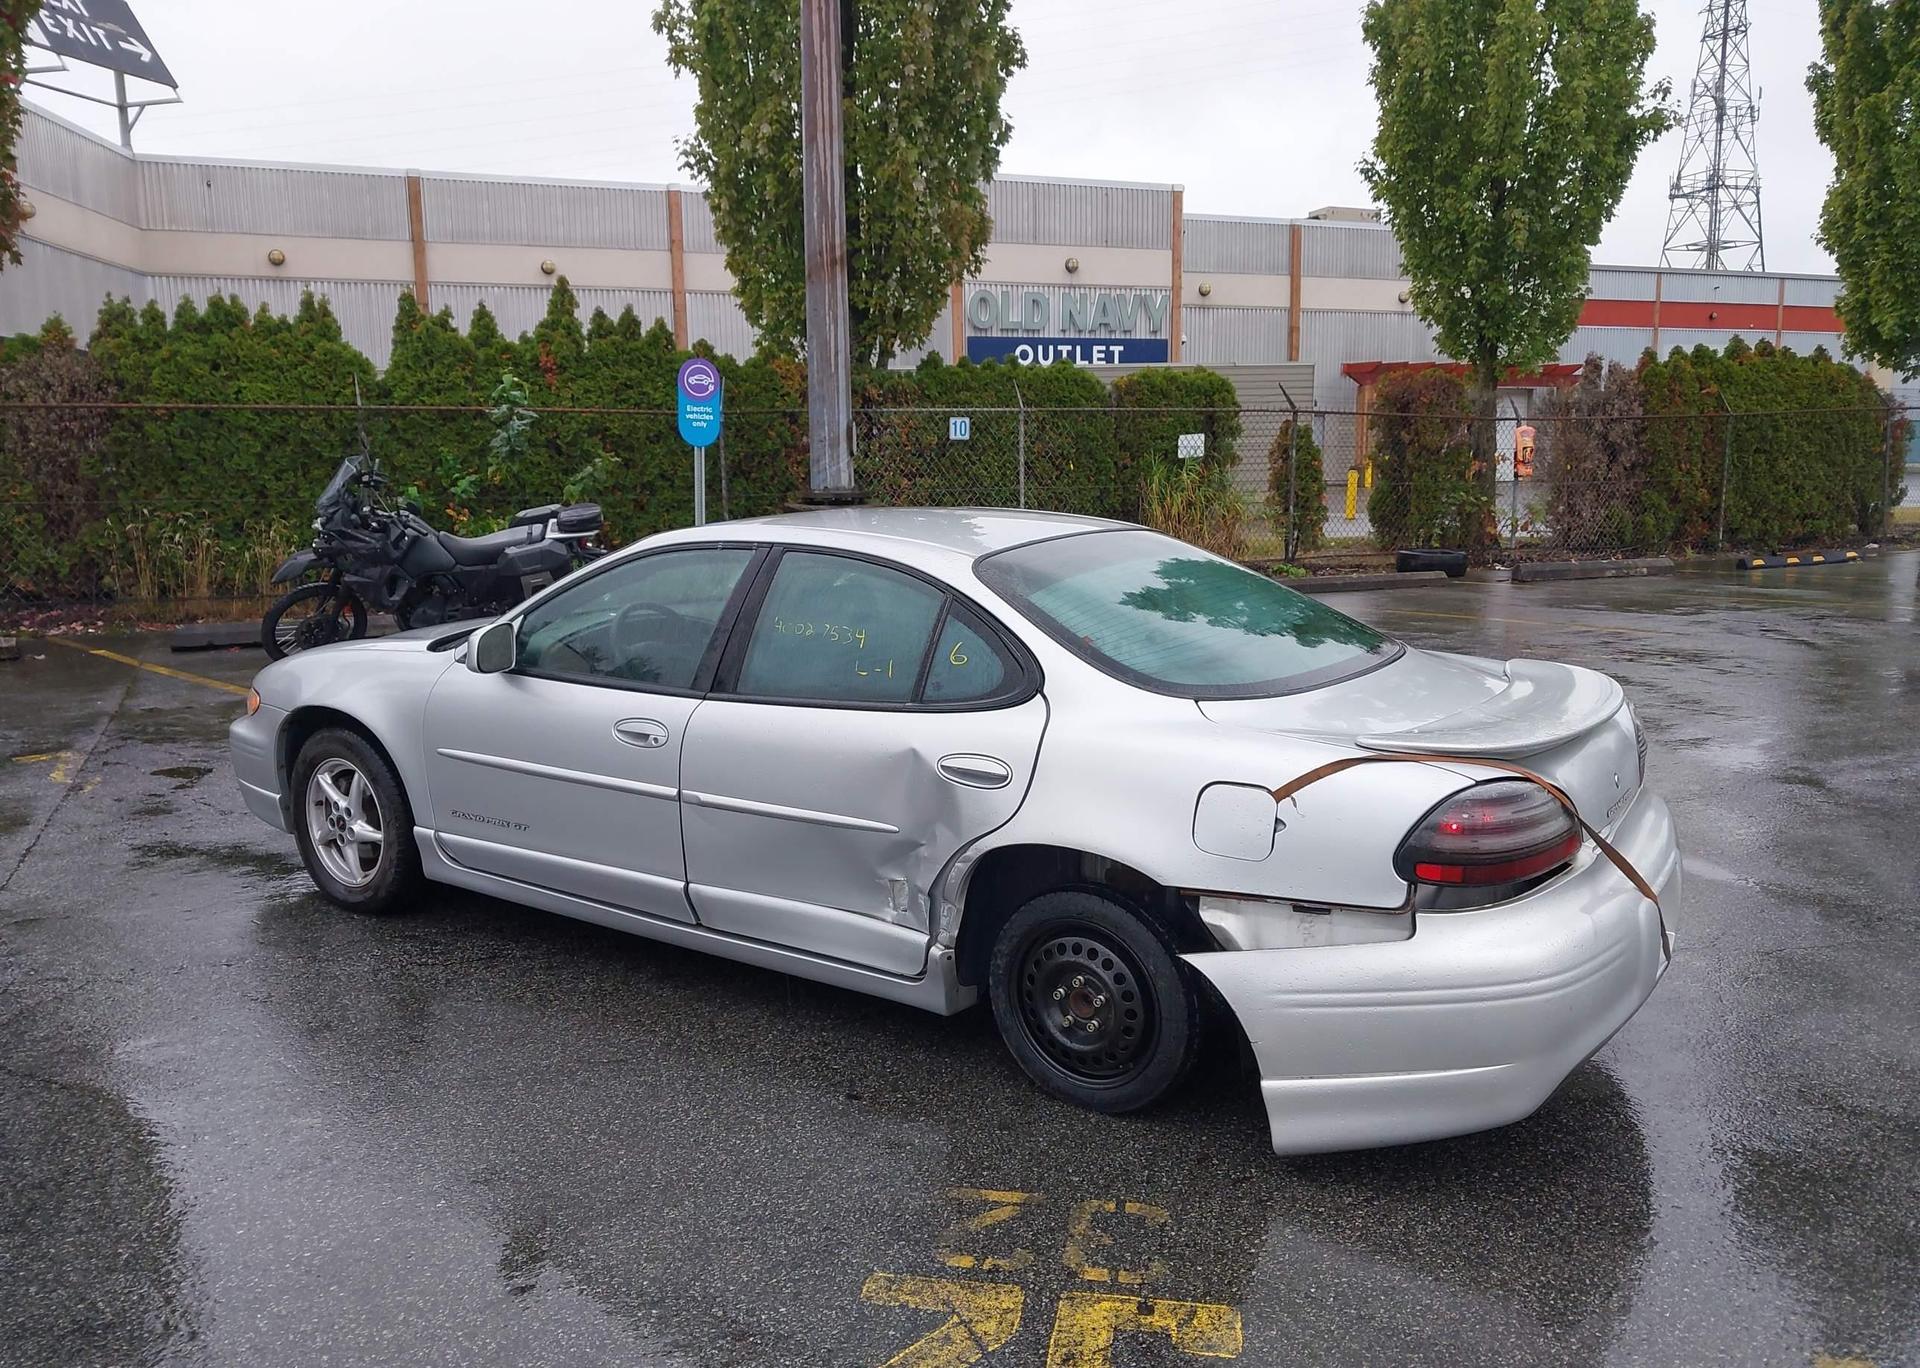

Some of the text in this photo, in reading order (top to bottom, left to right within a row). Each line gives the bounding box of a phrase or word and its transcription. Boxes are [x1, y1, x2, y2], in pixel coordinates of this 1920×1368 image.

[39, 9, 112, 50] EXIT
[968, 289, 1169, 333] OLD NAVY
[1014, 344, 1124, 365] OUTLET
[685, 413, 714, 421] vehicles
[686, 404, 713, 413] Electric
[952, 420, 967, 437] 10
[950, 641, 968, 665] 6
